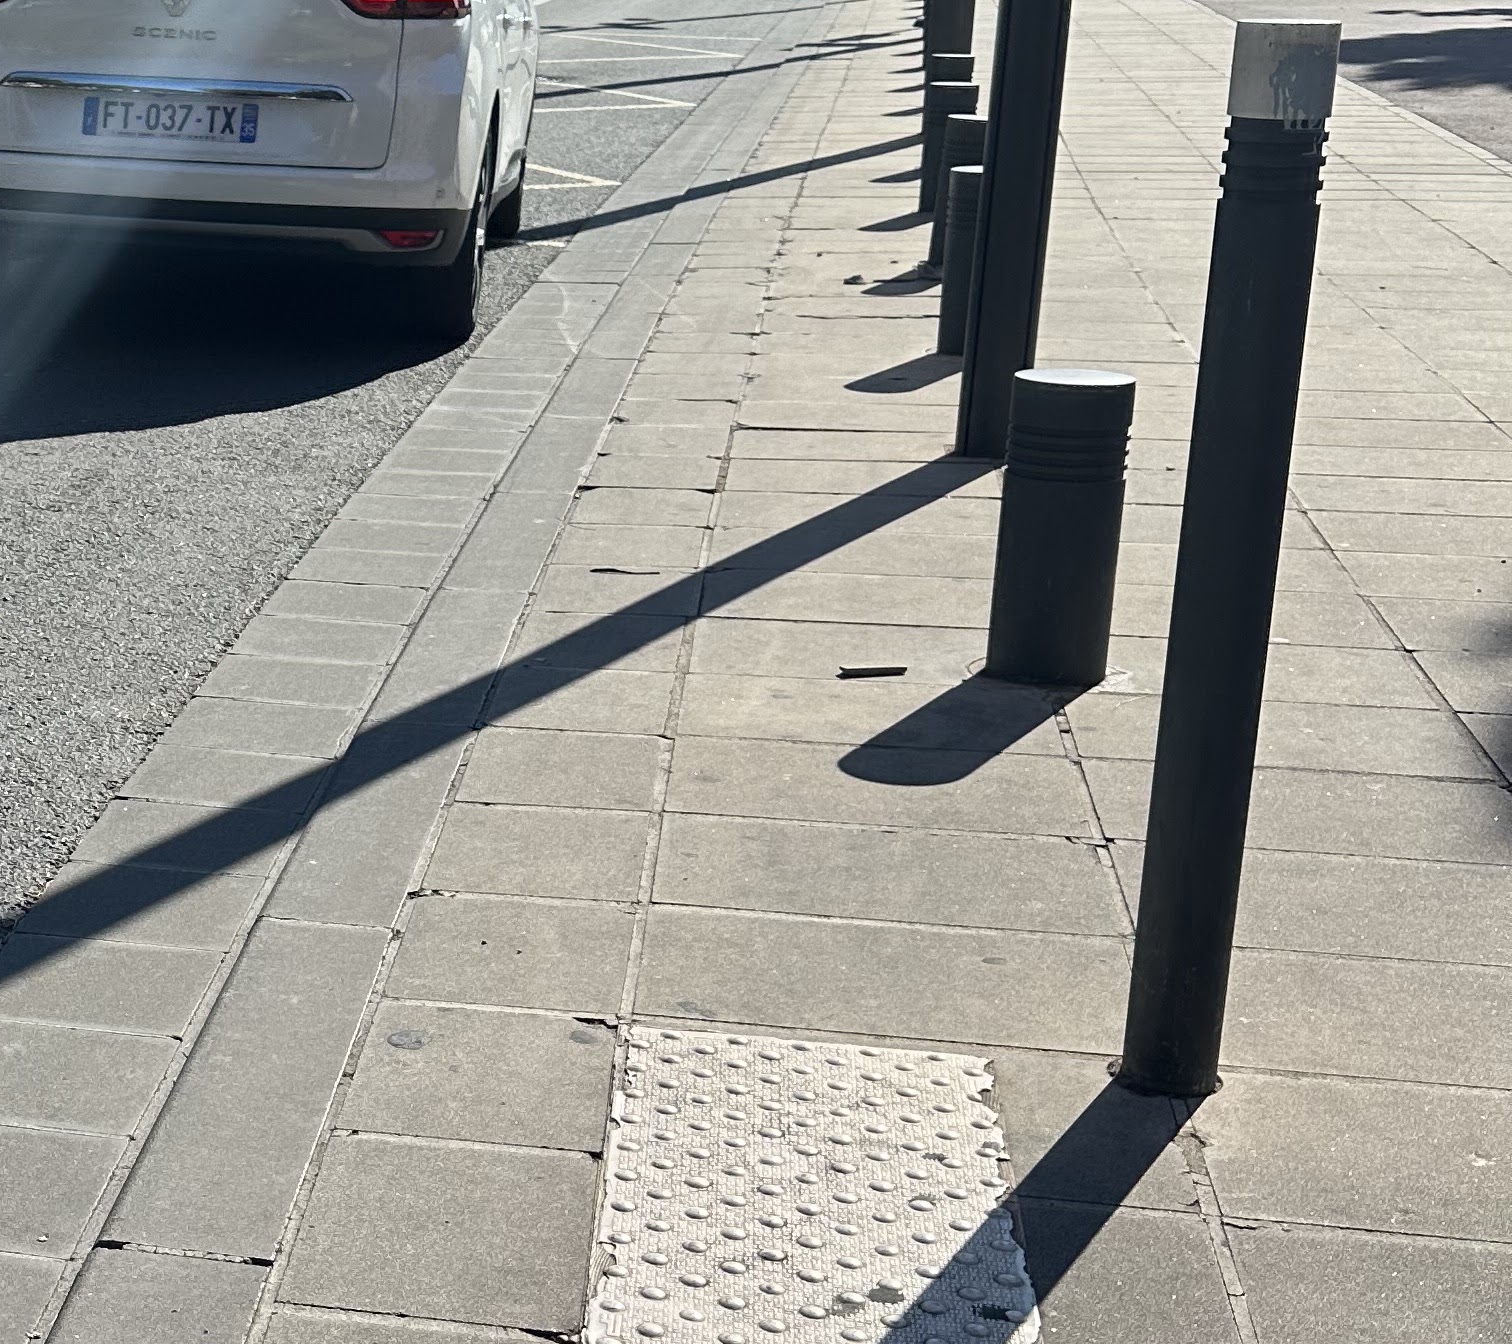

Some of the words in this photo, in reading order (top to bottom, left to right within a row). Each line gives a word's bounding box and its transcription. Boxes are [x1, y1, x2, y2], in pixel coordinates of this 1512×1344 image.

[131, 26, 217, 41] SCENIC
[102, 101, 238, 135] FT-037-TX
[241, 122, 255, 137] 35
